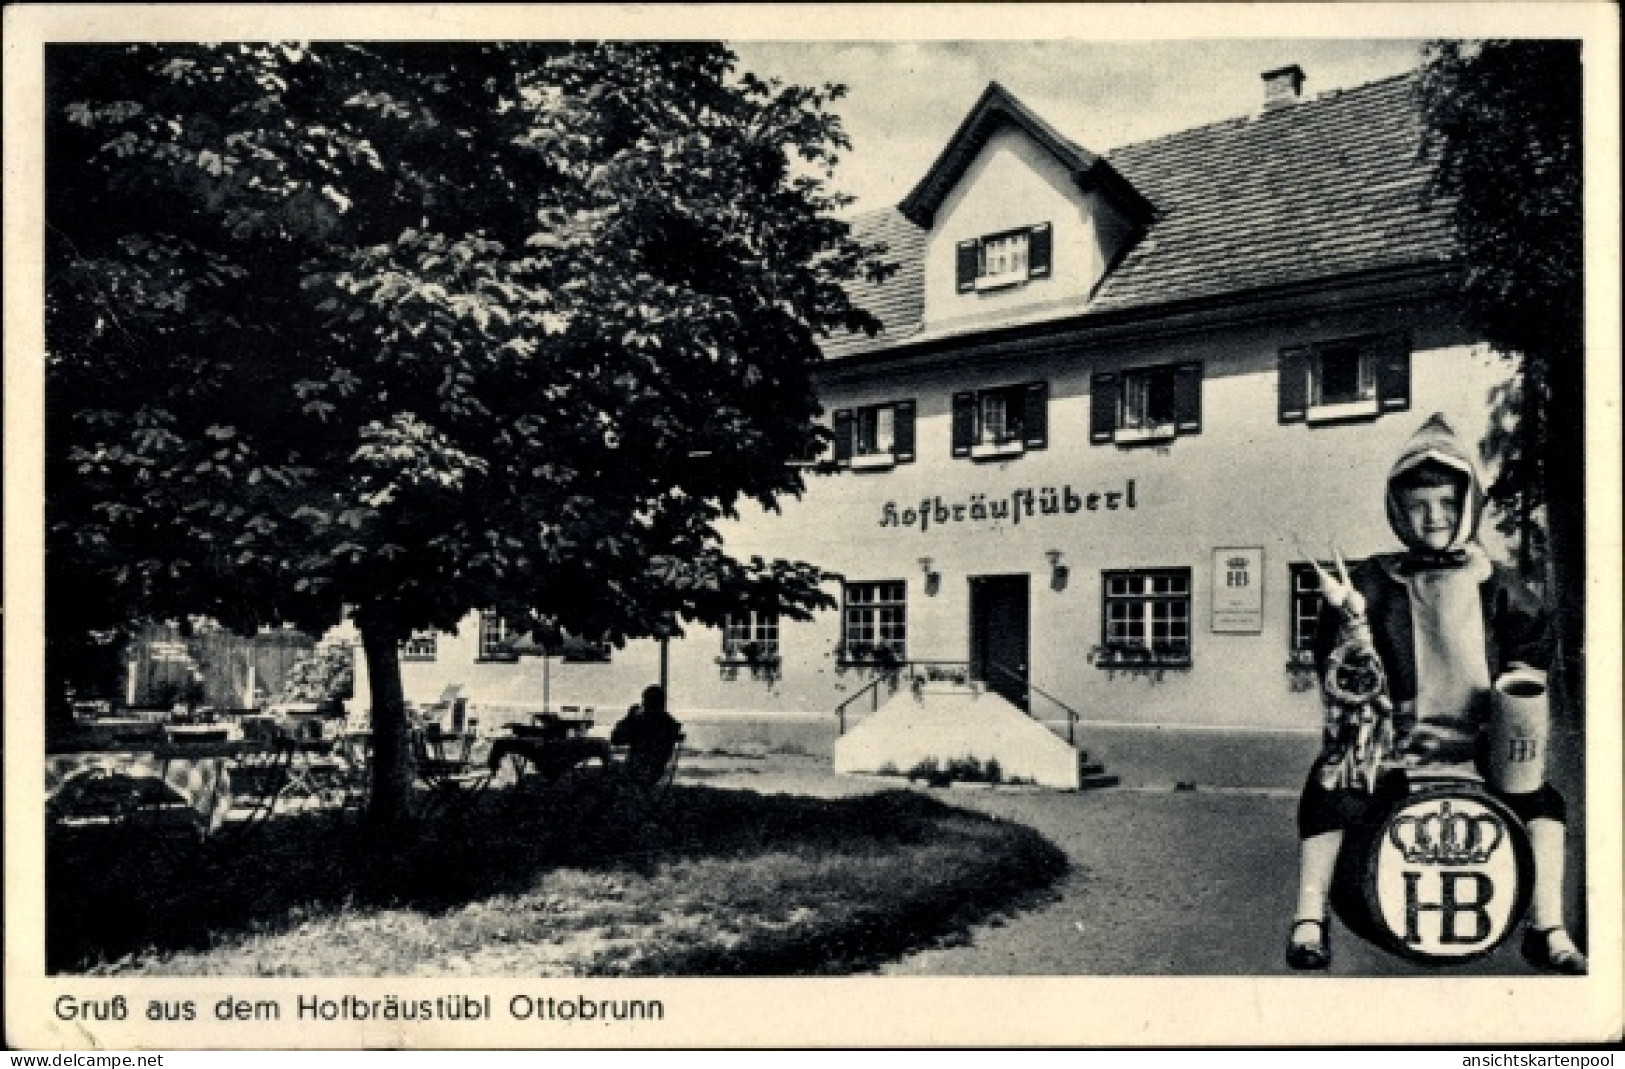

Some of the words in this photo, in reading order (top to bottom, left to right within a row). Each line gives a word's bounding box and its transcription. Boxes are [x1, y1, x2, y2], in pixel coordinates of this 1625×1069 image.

[1226, 571, 1250, 587] HB
[1509, 738, 1536, 762] HB
[1401, 871, 1494, 945] HB
